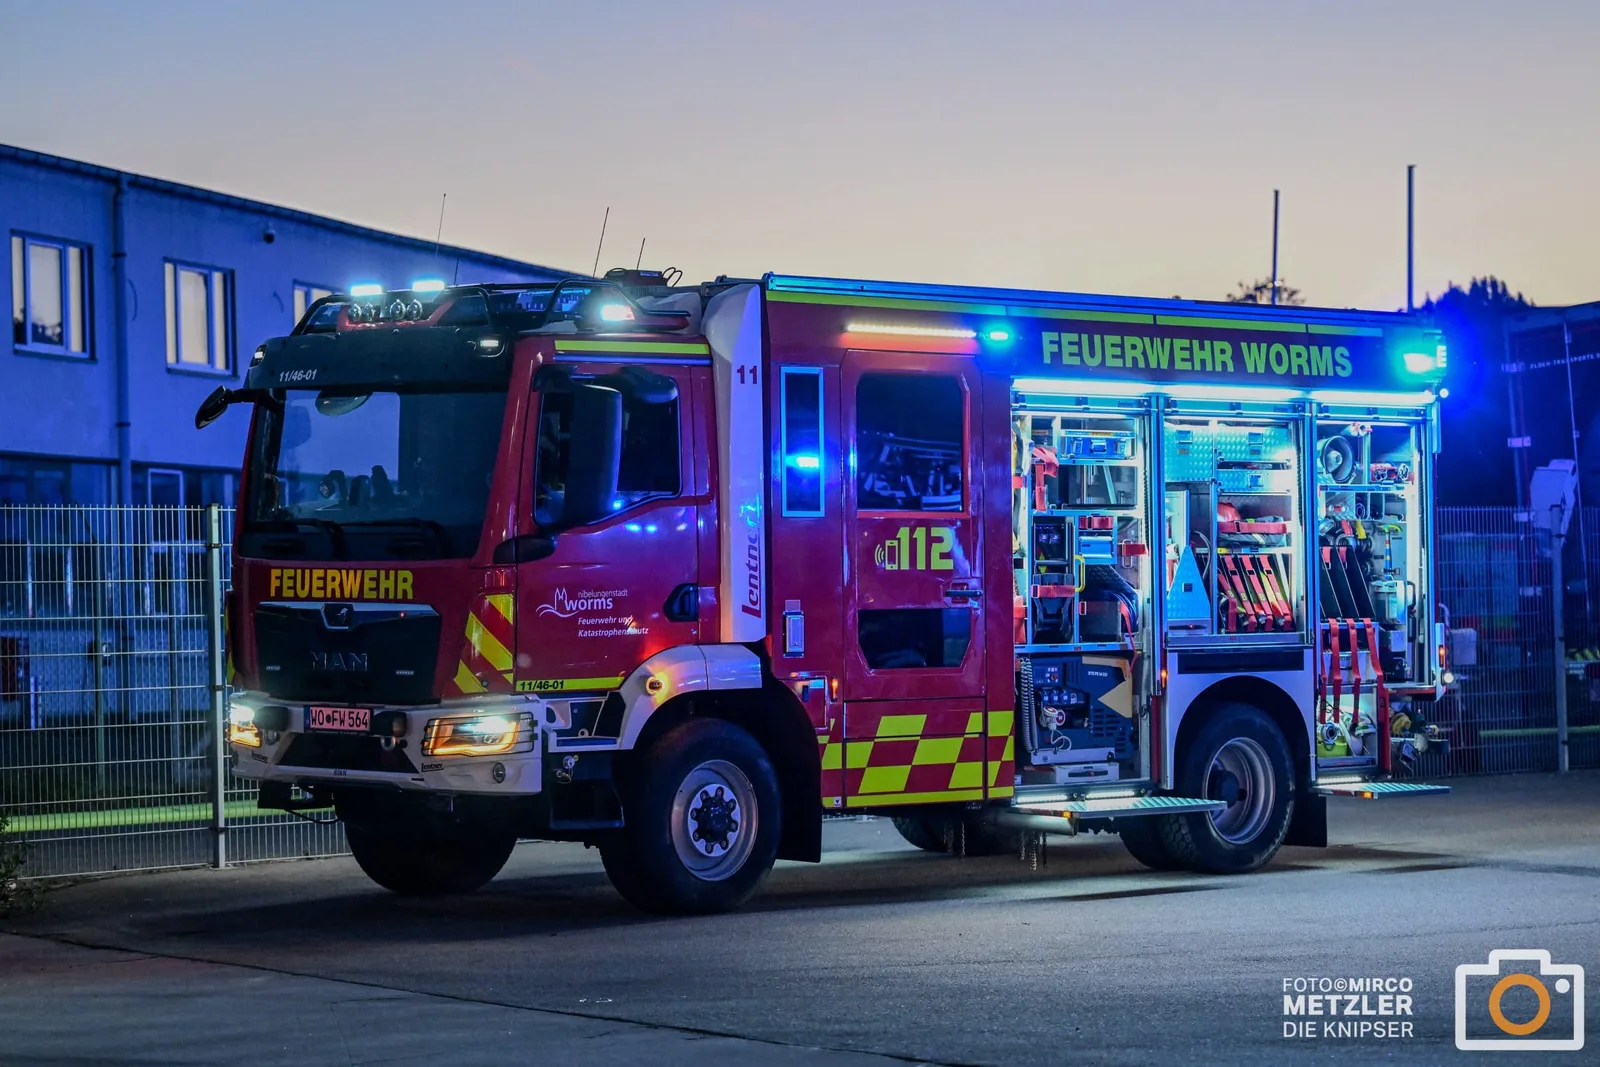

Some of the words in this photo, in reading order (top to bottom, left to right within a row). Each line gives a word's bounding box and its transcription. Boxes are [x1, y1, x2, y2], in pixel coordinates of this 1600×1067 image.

[1042, 331, 1234, 372] FEUERWEHR
[1240, 341, 1353, 378] WORMS
[279, 369, 318, 382] 11/46-01
[737, 365, 758, 384] 11
[896, 527, 954, 570] 112
[270, 568, 414, 600] FEUERWEHR
[577, 589, 629, 599] nibelungenstadt
[564, 597, 614, 612] worms
[577, 616, 618, 626] Feuerwehr
[310, 651, 369, 673] MAN
[519, 680, 565, 691] 11/46-01
[310, 709, 325, 726] WO
[331, 710, 346, 727] FW
[348, 711, 369, 728] 564
